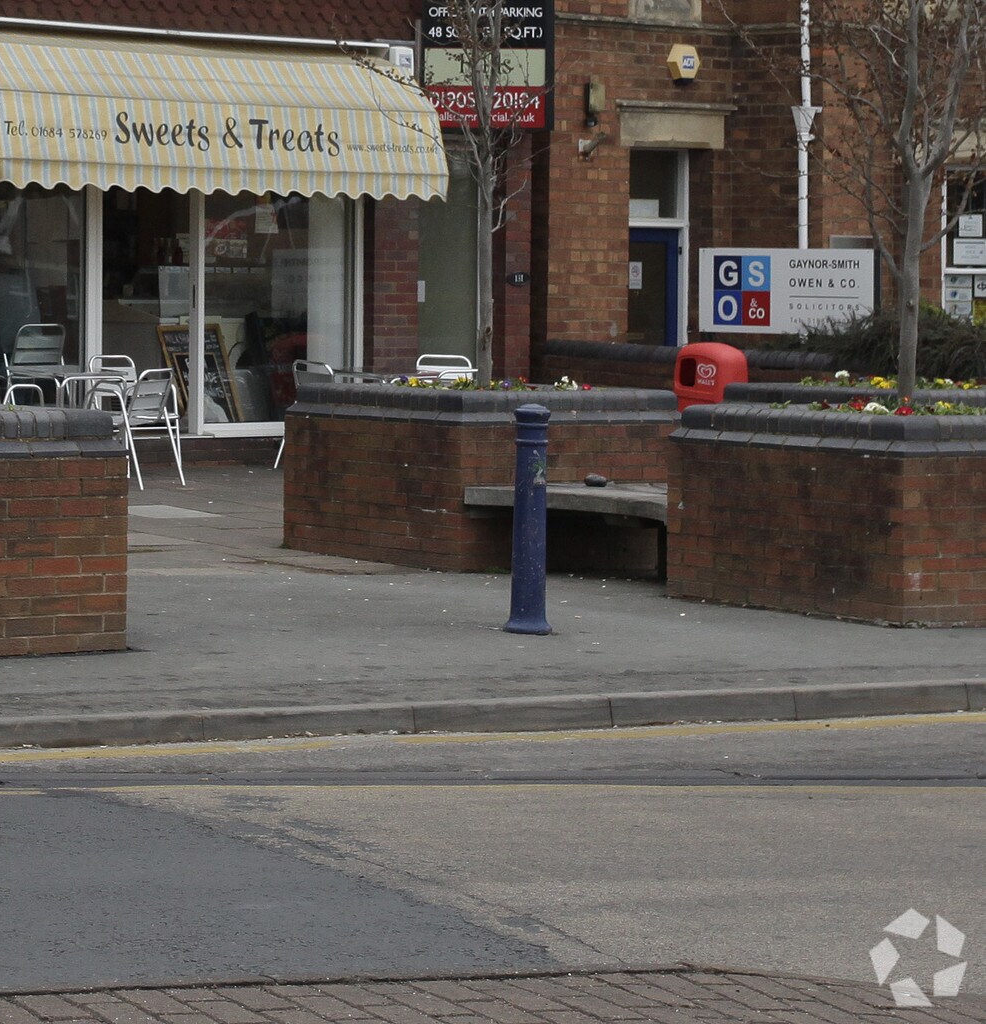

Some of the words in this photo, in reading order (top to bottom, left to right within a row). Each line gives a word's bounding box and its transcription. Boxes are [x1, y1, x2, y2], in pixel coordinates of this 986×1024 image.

[501, 7, 543, 18] PARKING
[429, 27, 442, 38] 48
[3, 120, 28, 137] Tel.
[31, 126, 63, 138] 01684
[69, 128, 108, 141] 578269
[115, 111, 211, 152] Sweets
[222, 116, 243, 149] &
[249, 118, 340, 157] Treats
[789, 259, 860, 269] GAYNOR-SMITH
[789, 278, 823, 289] OWEN
[827, 278, 835, 288] &
[840, 278, 860, 289] CO.
[789, 303, 860, 312] SOLICITORS
[748, 308, 765, 320] CO
